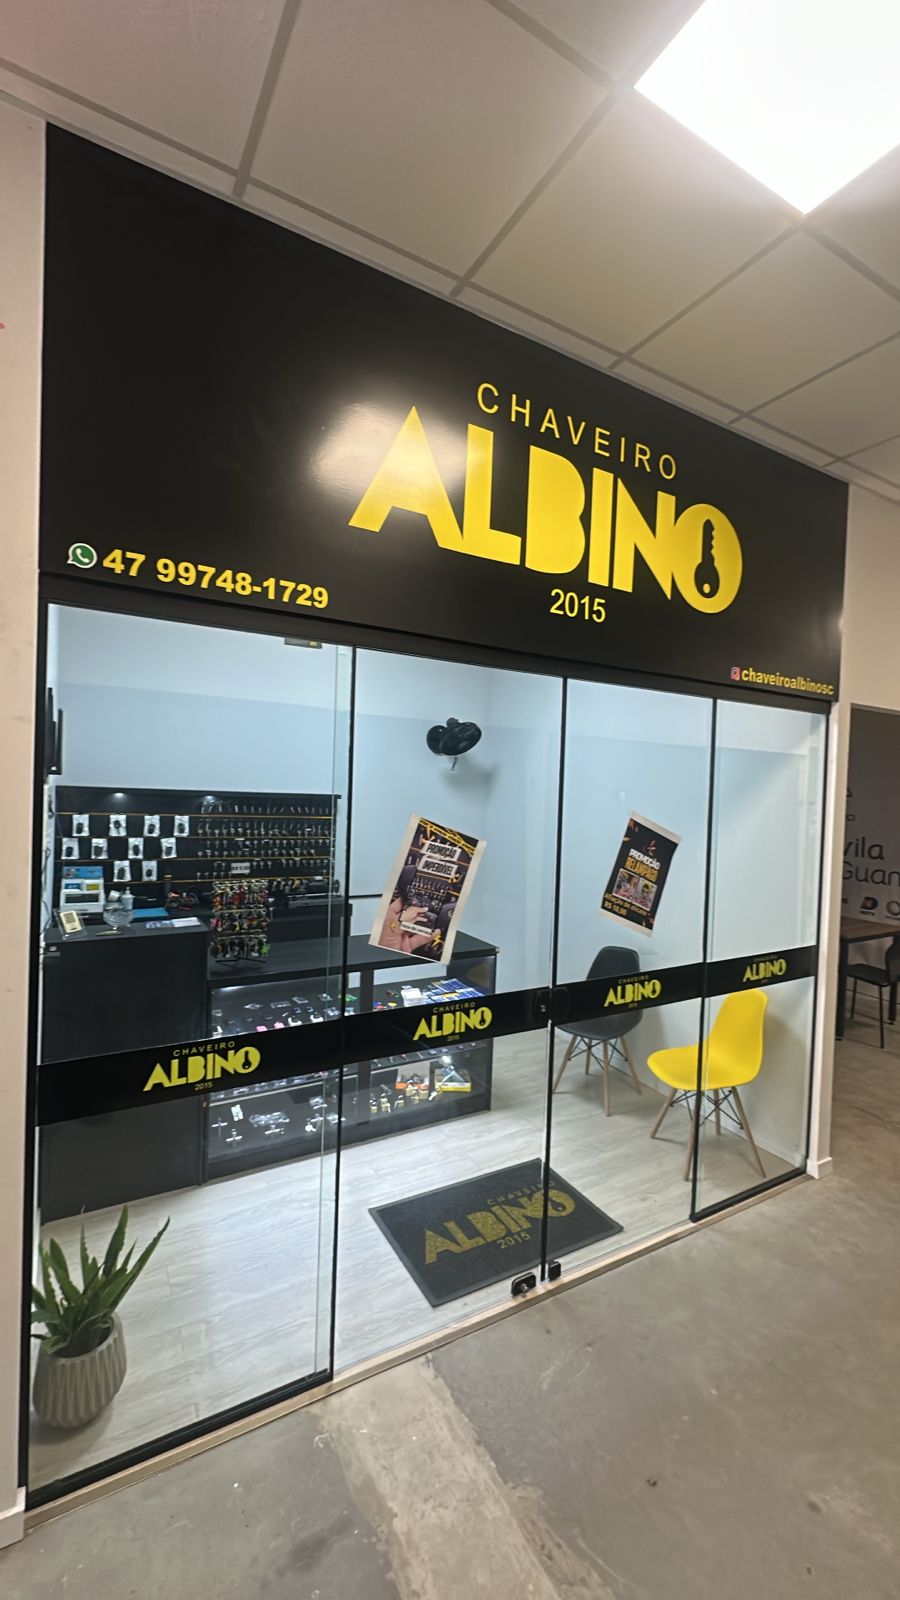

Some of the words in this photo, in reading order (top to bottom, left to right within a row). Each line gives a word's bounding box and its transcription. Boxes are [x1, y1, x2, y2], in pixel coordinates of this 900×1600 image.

[477, 383, 677, 480] CHAVEIRO
[347, 405, 743, 614] ALBINO
[102, 549, 146, 577] 47
[156, 558, 329, 609] 99748-1729
[549, 588, 606, 623] 2015
[741, 667, 834, 695] chaveiroalbinosc
[742, 959, 787, 983] ALBINO
[433, 1001, 476, 1014] CHAVEIRO
[603, 979, 662, 1007] ALBINO
[412, 1006, 493, 1041] ALBINO
[173, 1041, 236, 1057] CHAVEIRO
[143, 1046, 261, 1092] ALBINO
[195, 1082, 213, 1091] 2015
[424, 1189, 576, 1264] ALBINO
[497, 1231, 531, 1248] 2015
